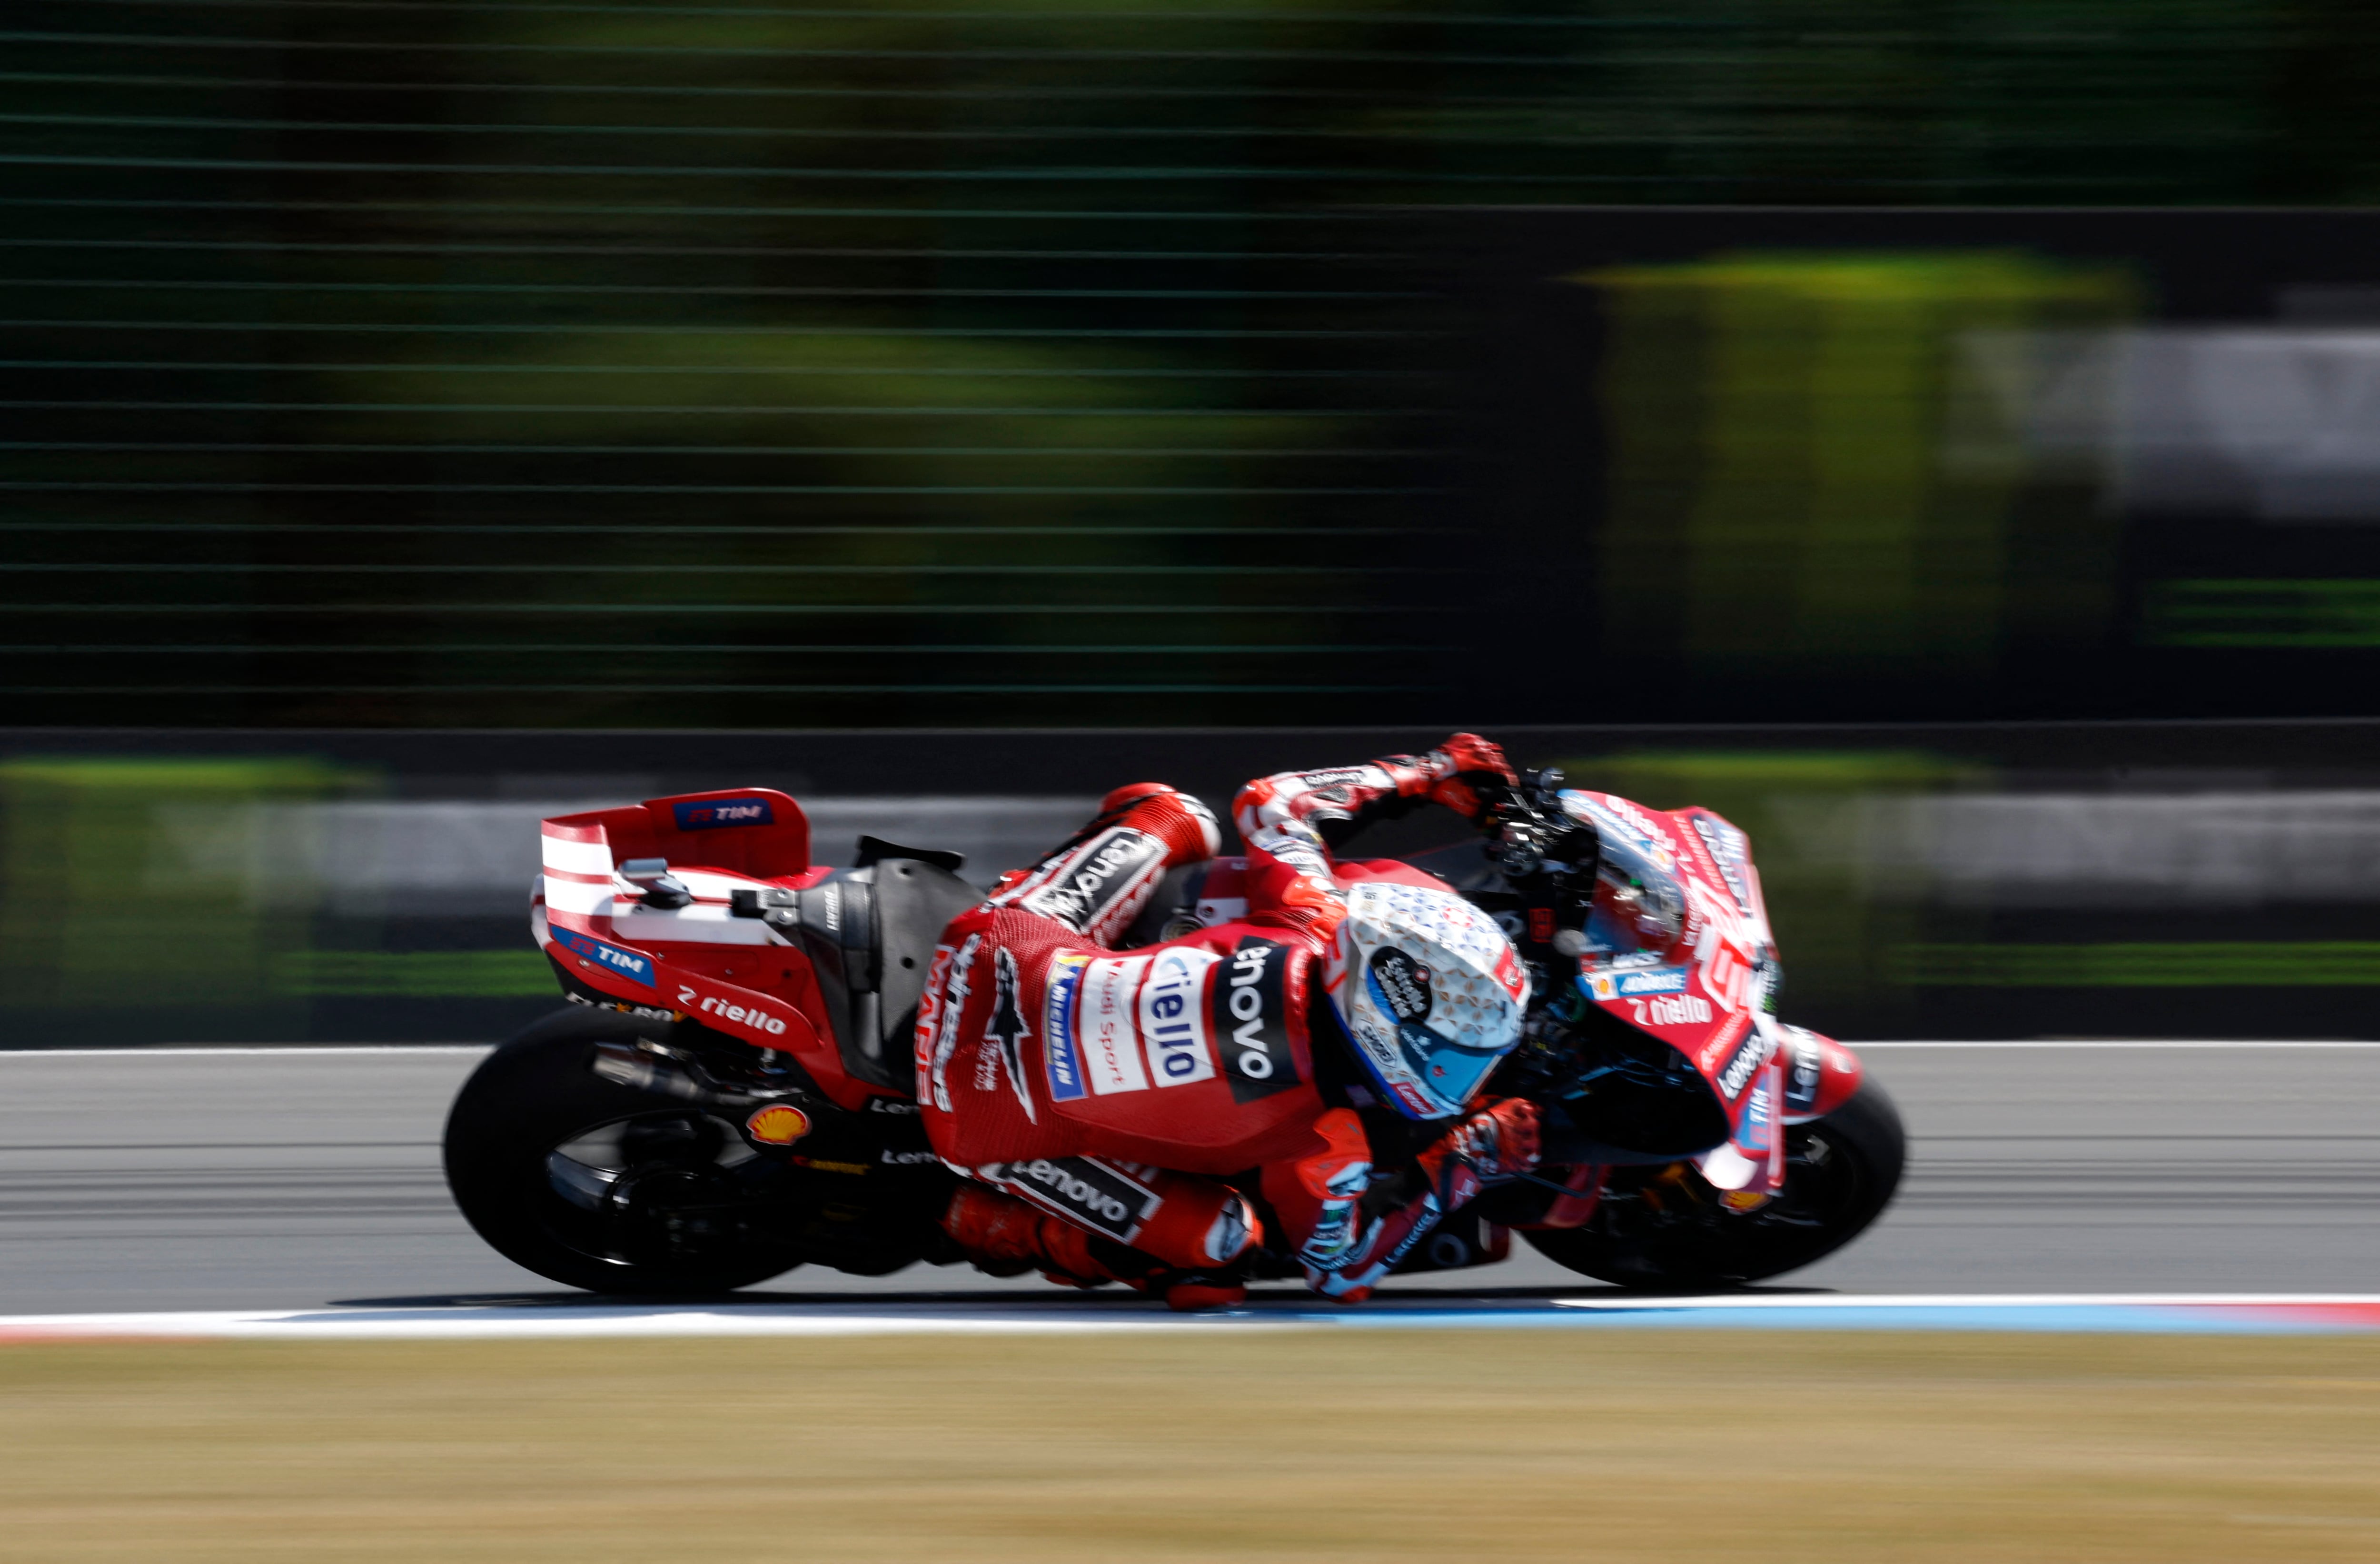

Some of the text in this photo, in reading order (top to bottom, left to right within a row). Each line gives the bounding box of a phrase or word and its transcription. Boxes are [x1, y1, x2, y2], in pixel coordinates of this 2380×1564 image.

[716, 805, 763, 820] TIM
[598, 946, 645, 973] TIM
[700, 996, 787, 1035] riello
[1150, 972, 1195, 1078] iello
[1229, 946, 1274, 1079] enovo
[1649, 994, 1713, 1026] riello
[1050, 985, 1074, 1086] MICHELIN
[1098, 970, 1126, 1086] Audi Sport
[870, 1098, 921, 1115] Len
[881, 1148, 939, 1164] Len
